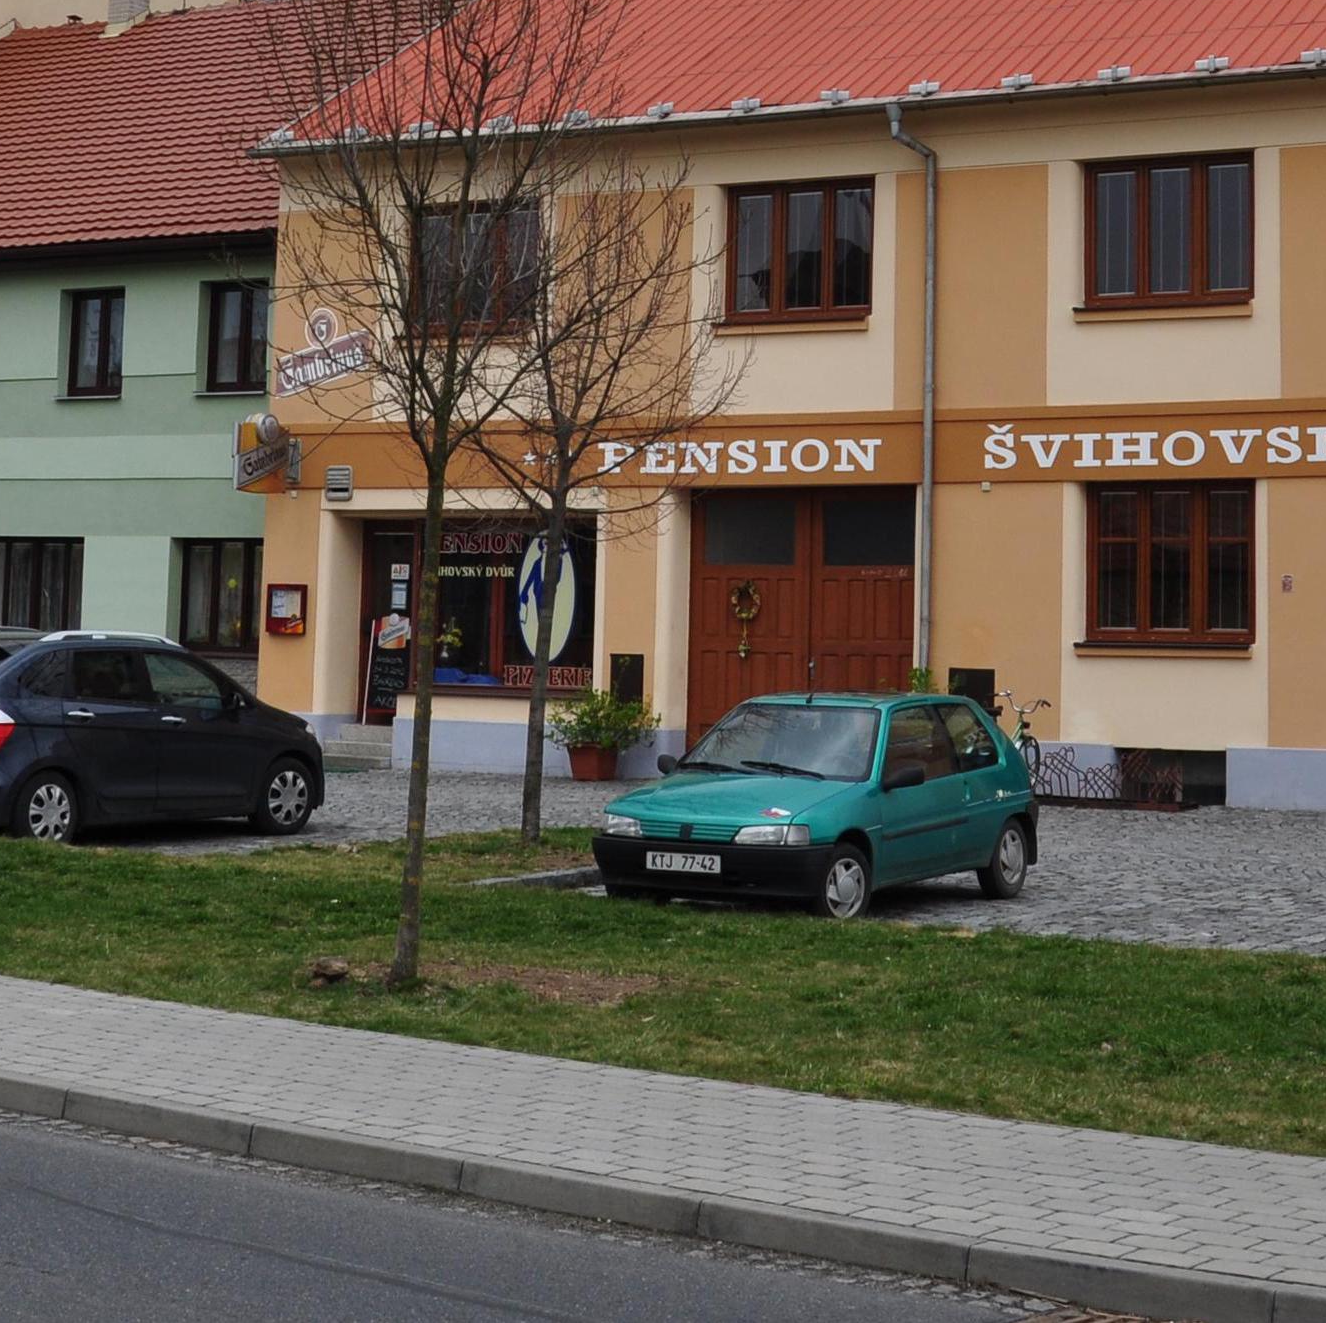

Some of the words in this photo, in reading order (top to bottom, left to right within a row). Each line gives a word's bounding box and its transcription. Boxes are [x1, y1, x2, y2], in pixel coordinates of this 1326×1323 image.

[597, 439, 882, 474] PENSION
[439, 533, 523, 554] ENSION
[438, 564, 483, 577] IHOVSKÝ
[485, 563, 515, 577] DVŮR
[504, 665, 592, 687] PIZERIE
[652, 853, 672, 868] KTJ
